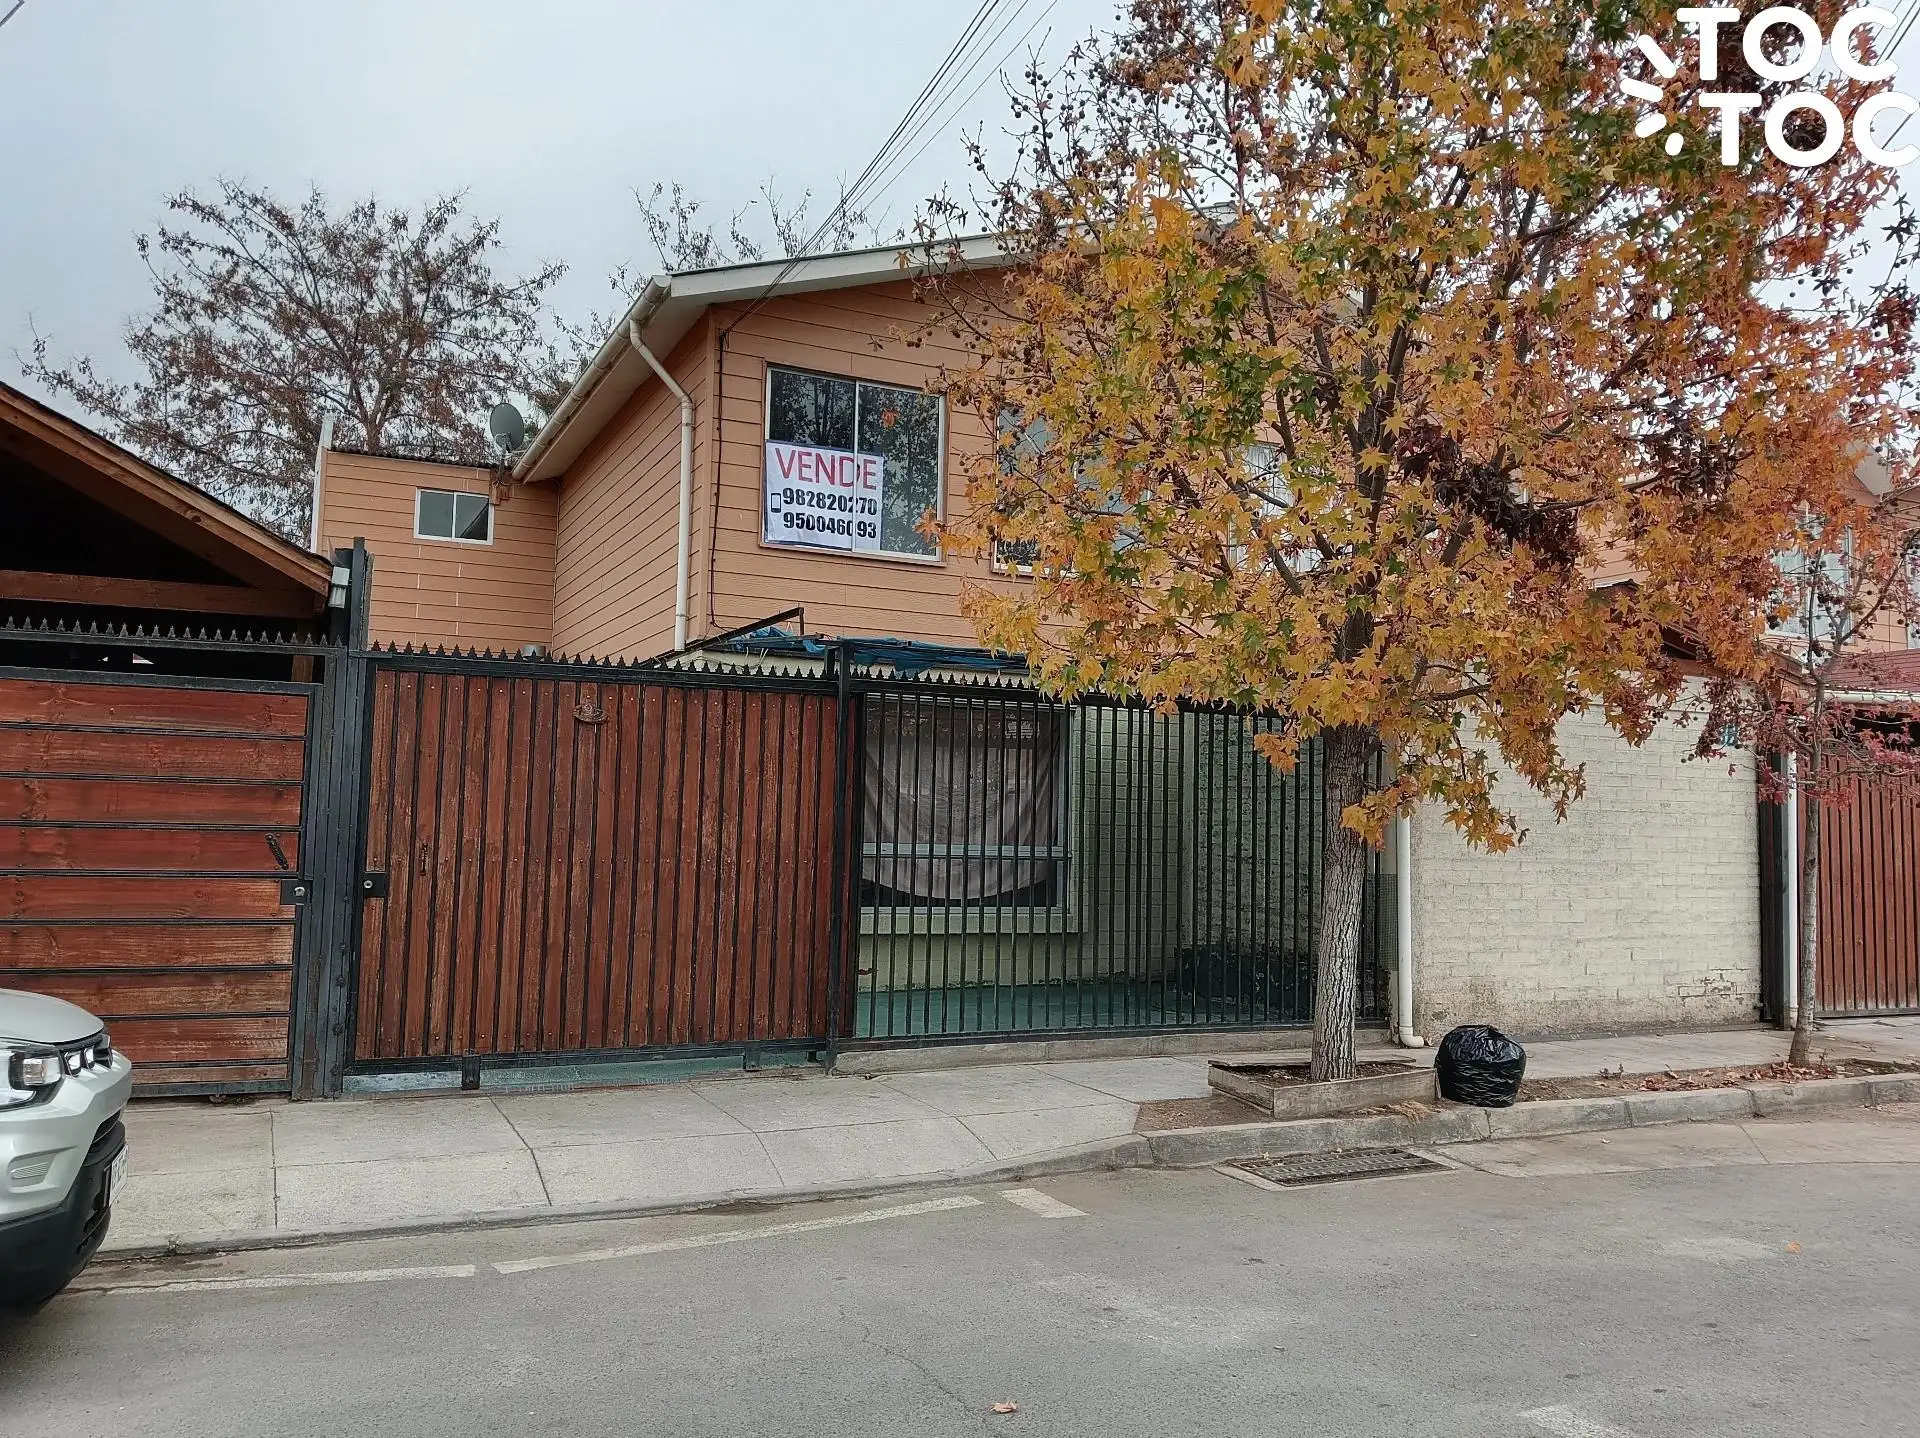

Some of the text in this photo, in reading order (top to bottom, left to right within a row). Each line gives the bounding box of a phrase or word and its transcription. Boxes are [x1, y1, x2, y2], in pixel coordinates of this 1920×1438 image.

[775, 448, 877, 491] VENDE
[782, 487, 878, 516] 982820270
[783, 511, 877, 539] 950046093
